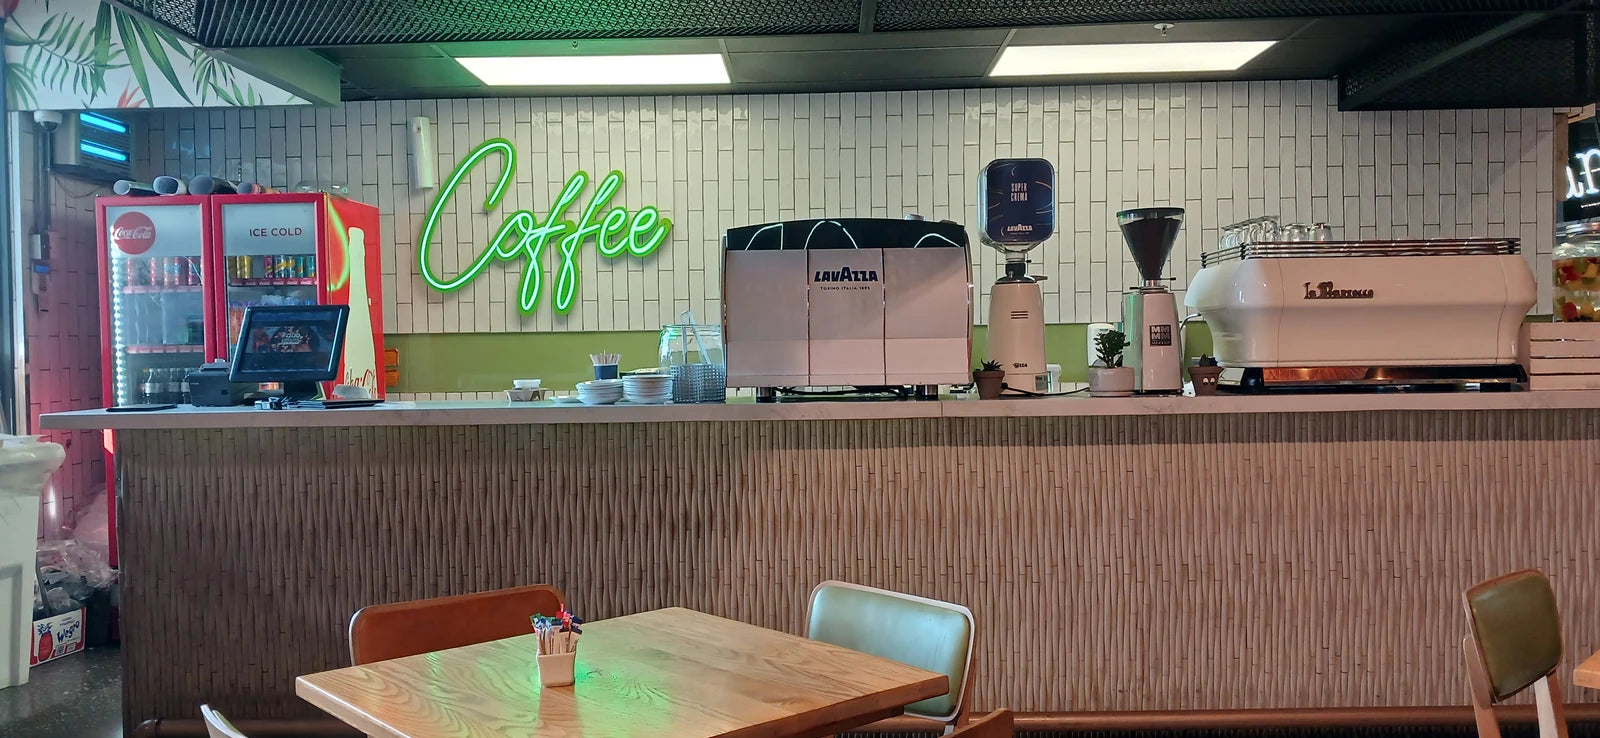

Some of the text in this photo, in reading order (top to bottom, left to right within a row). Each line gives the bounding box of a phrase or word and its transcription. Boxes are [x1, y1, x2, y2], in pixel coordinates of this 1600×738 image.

[1011, 183, 1027, 192] SUPER
[1010, 192, 1028, 202] CREMA
[249, 227, 303, 237] ICE COLD
[419, 138, 673, 316] Coffee
[814, 266, 878, 282] LAVAZZA
